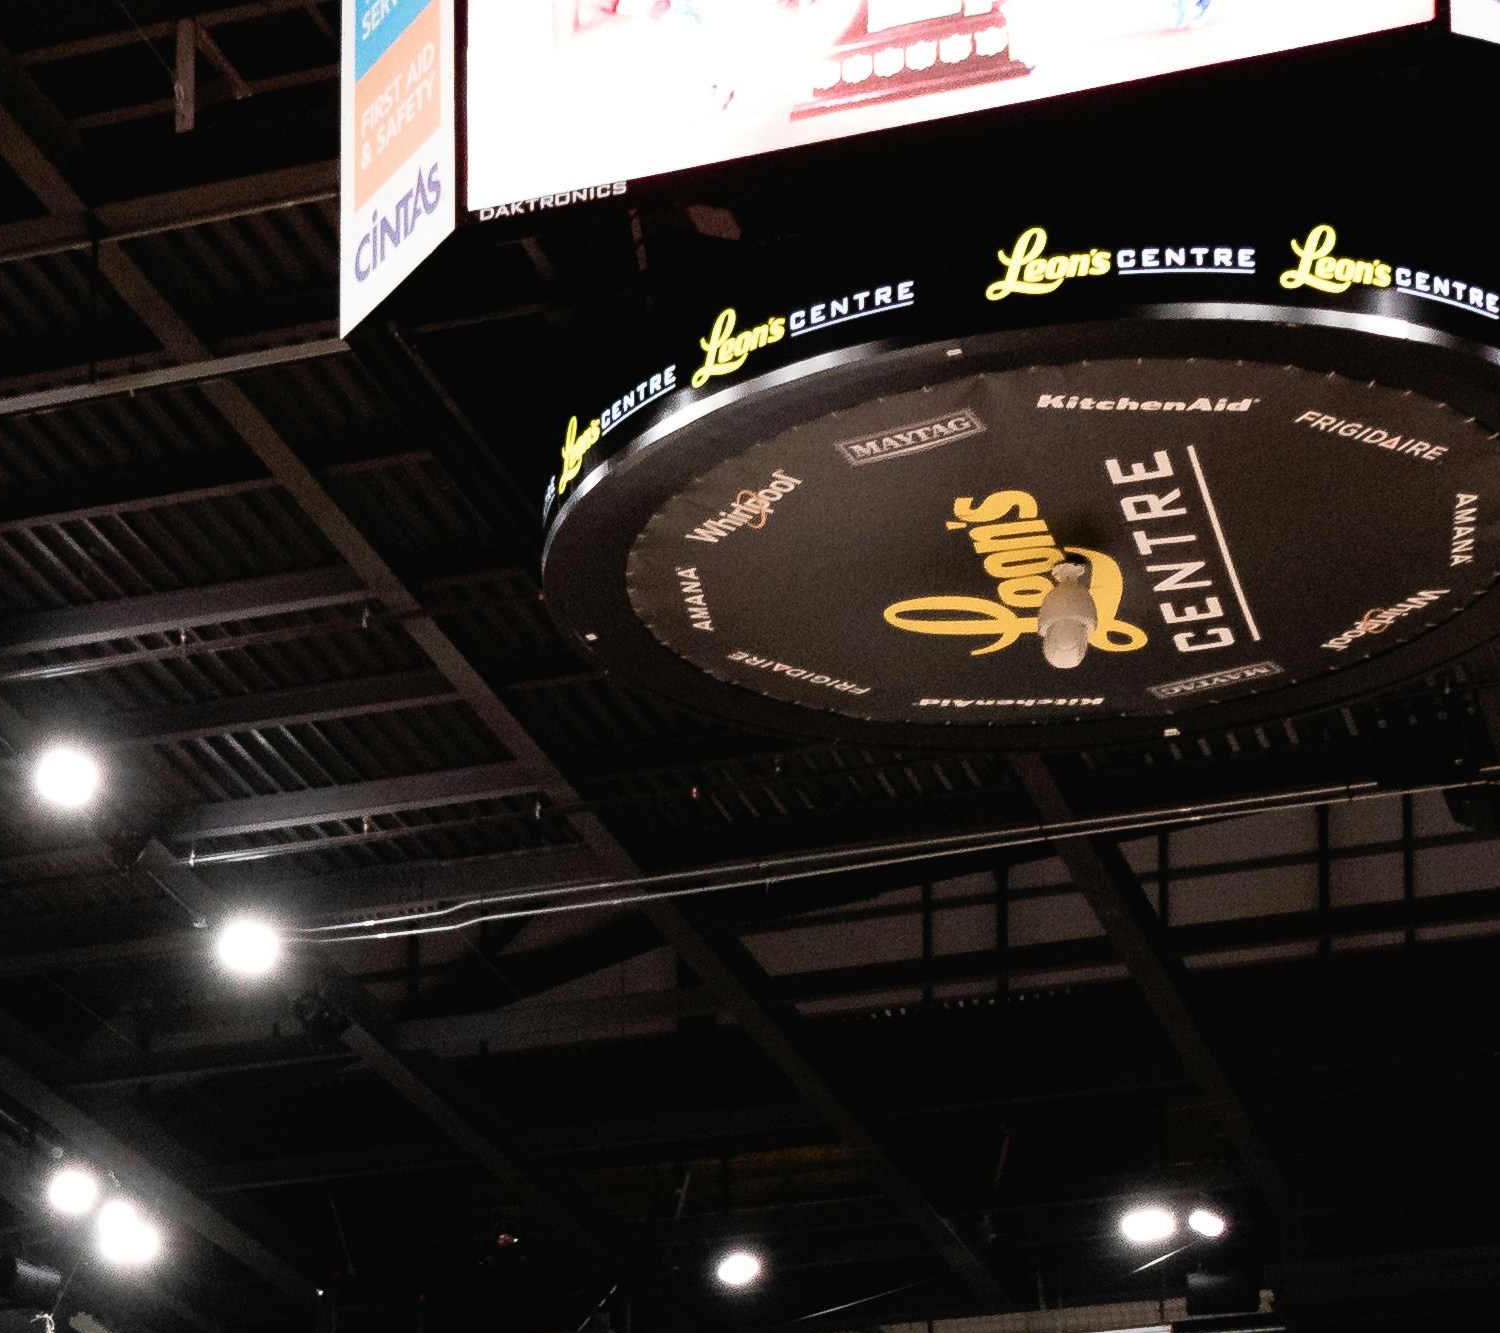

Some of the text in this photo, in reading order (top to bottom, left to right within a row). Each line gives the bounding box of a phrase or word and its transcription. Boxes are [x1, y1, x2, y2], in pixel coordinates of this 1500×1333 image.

[361, 43, 435, 138] FIRST AID
[361, 75, 436, 170] & SAFETY
[479, 180, 628, 222] DAKTRONICS
[986, 227, 1256, 301] Leon's CENTRE
[1279, 224, 1500, 313] Leon's CENTRE
[691, 280, 915, 388] Leon's CENTRE
[559, 365, 676, 494] Leon's CENTRE
[847, 415, 976, 461] MAYTAG
[1035, 394, 1262, 412] KitchenAid
[1294, 411, 1450, 461] FRIGIDAIRE
[686, 468, 803, 545] Whirlpool
[1449, 493, 1479, 567] AMANA
[1105, 449, 1236, 653] CENTRE
[676, 565, 714, 632] AMANA
[1319, 589, 1451, 652] Whirlpool
[727, 650, 872, 695] FRIGIDAIRE
[912, 697, 1106, 707] KitchenAid
[1163, 664, 1272, 697] MAYTAG
